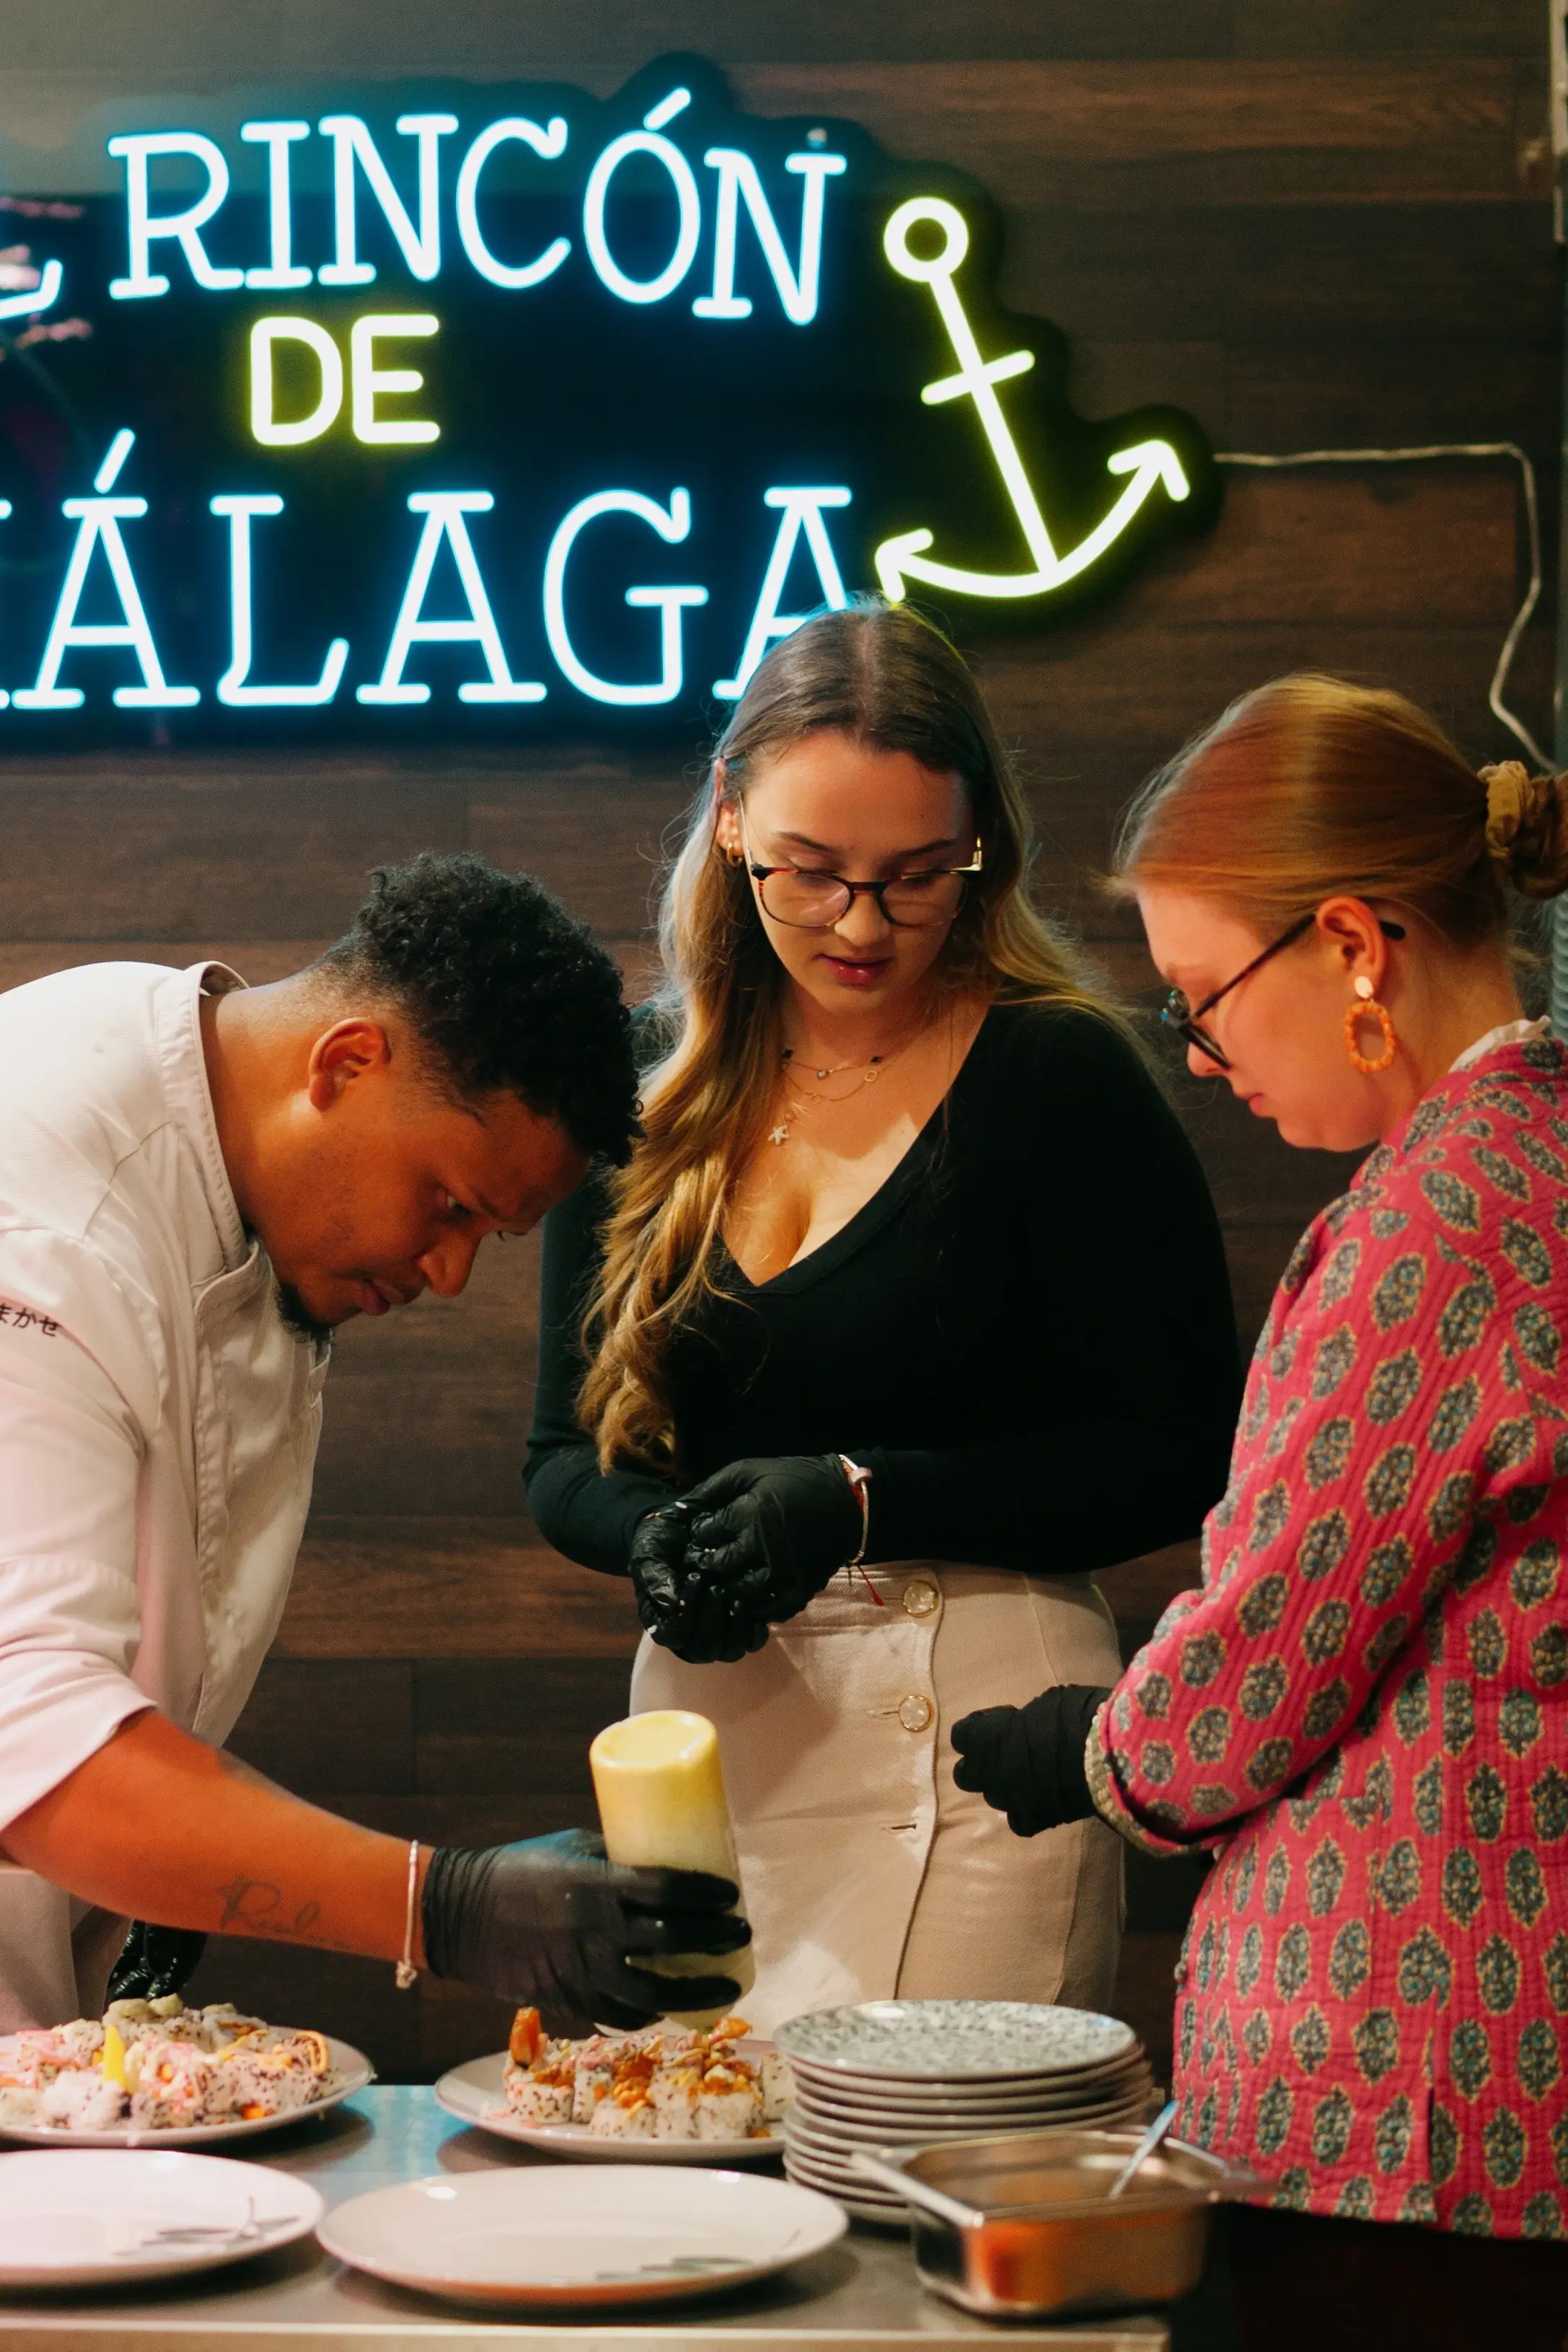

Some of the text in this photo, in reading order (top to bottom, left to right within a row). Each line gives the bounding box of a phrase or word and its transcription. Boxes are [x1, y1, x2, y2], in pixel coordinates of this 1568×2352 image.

[107, 87, 847, 325] RINCÓN
[250, 315, 441, 446] DE
[0, 429, 854, 709] ÁLAGA
